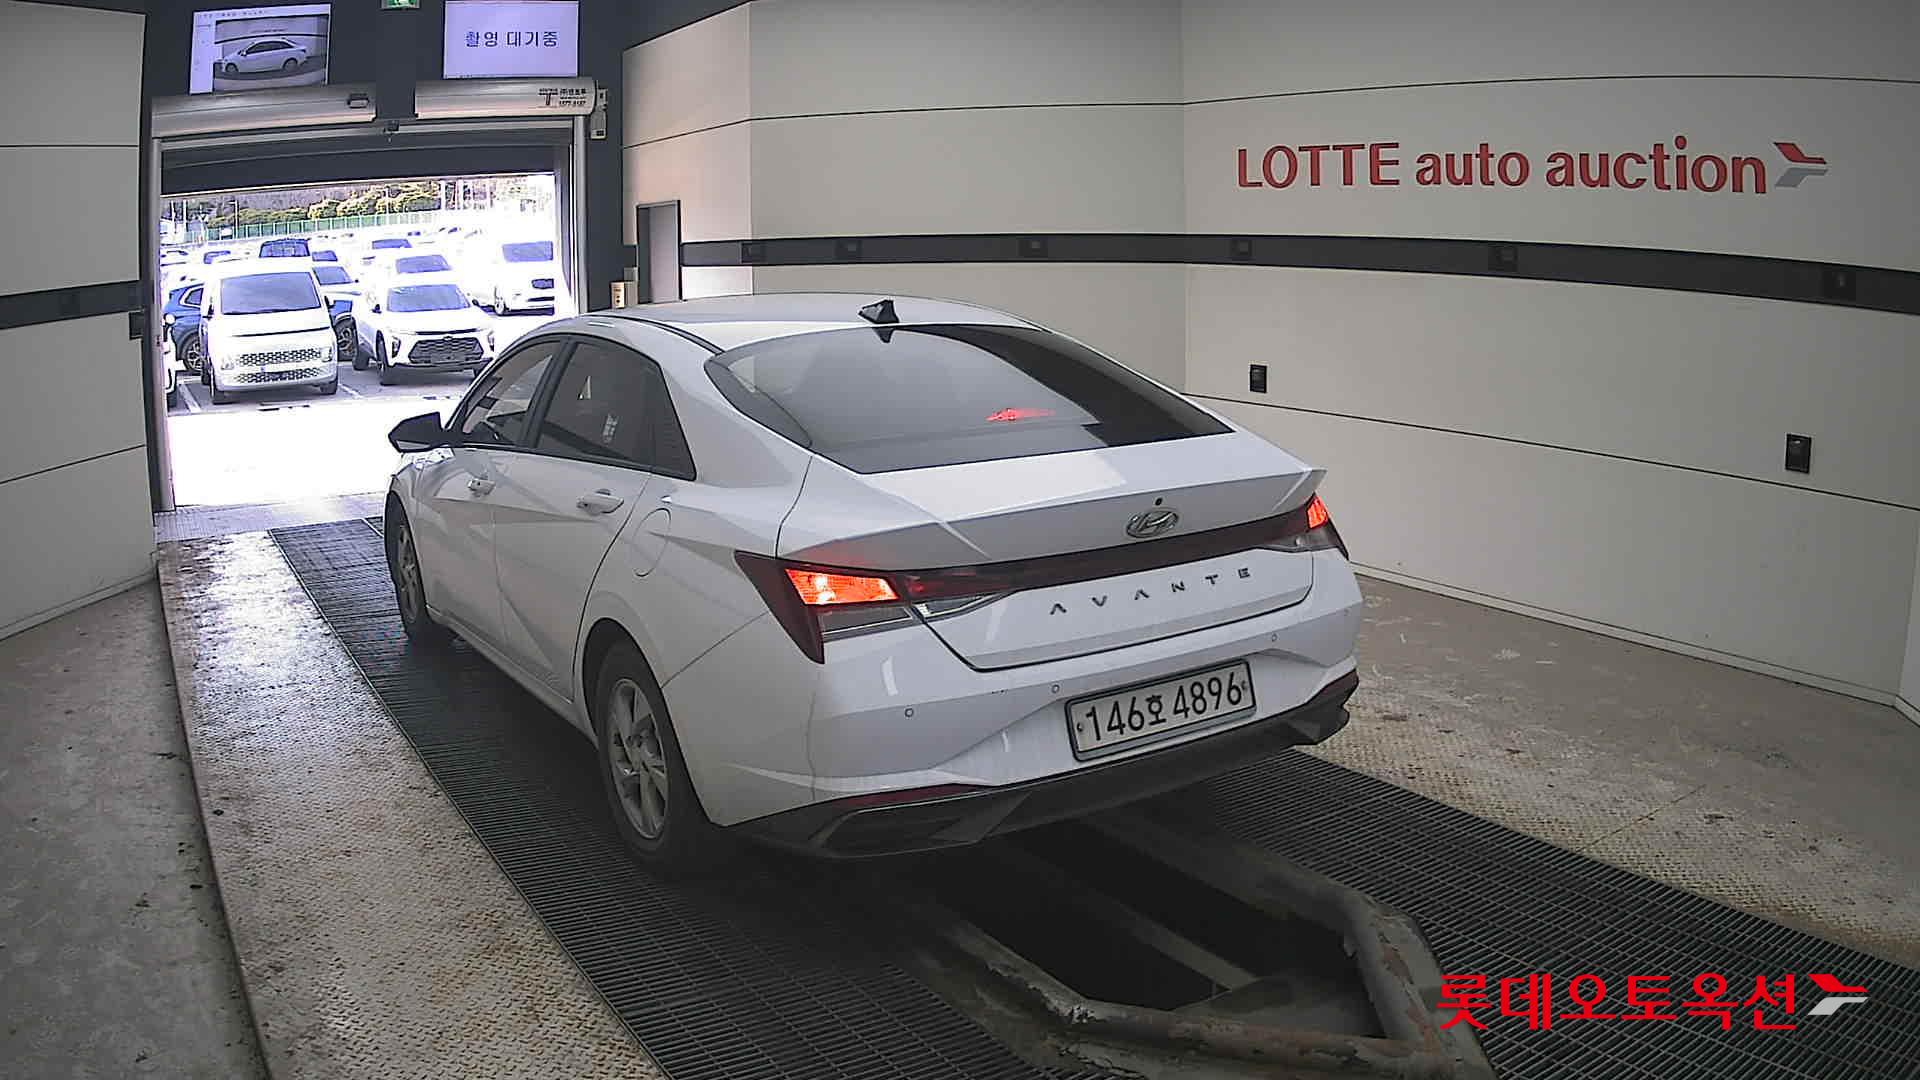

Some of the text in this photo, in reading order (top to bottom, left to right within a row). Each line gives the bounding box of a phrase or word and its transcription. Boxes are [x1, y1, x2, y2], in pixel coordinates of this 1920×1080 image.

[465, 31, 559, 48] 촬영 대기중
[1237, 135, 1767, 194] LOTTE auto auction
[1050, 567, 1251, 615] AVANTE
[1085, 671, 1243, 741] 146호 4896
